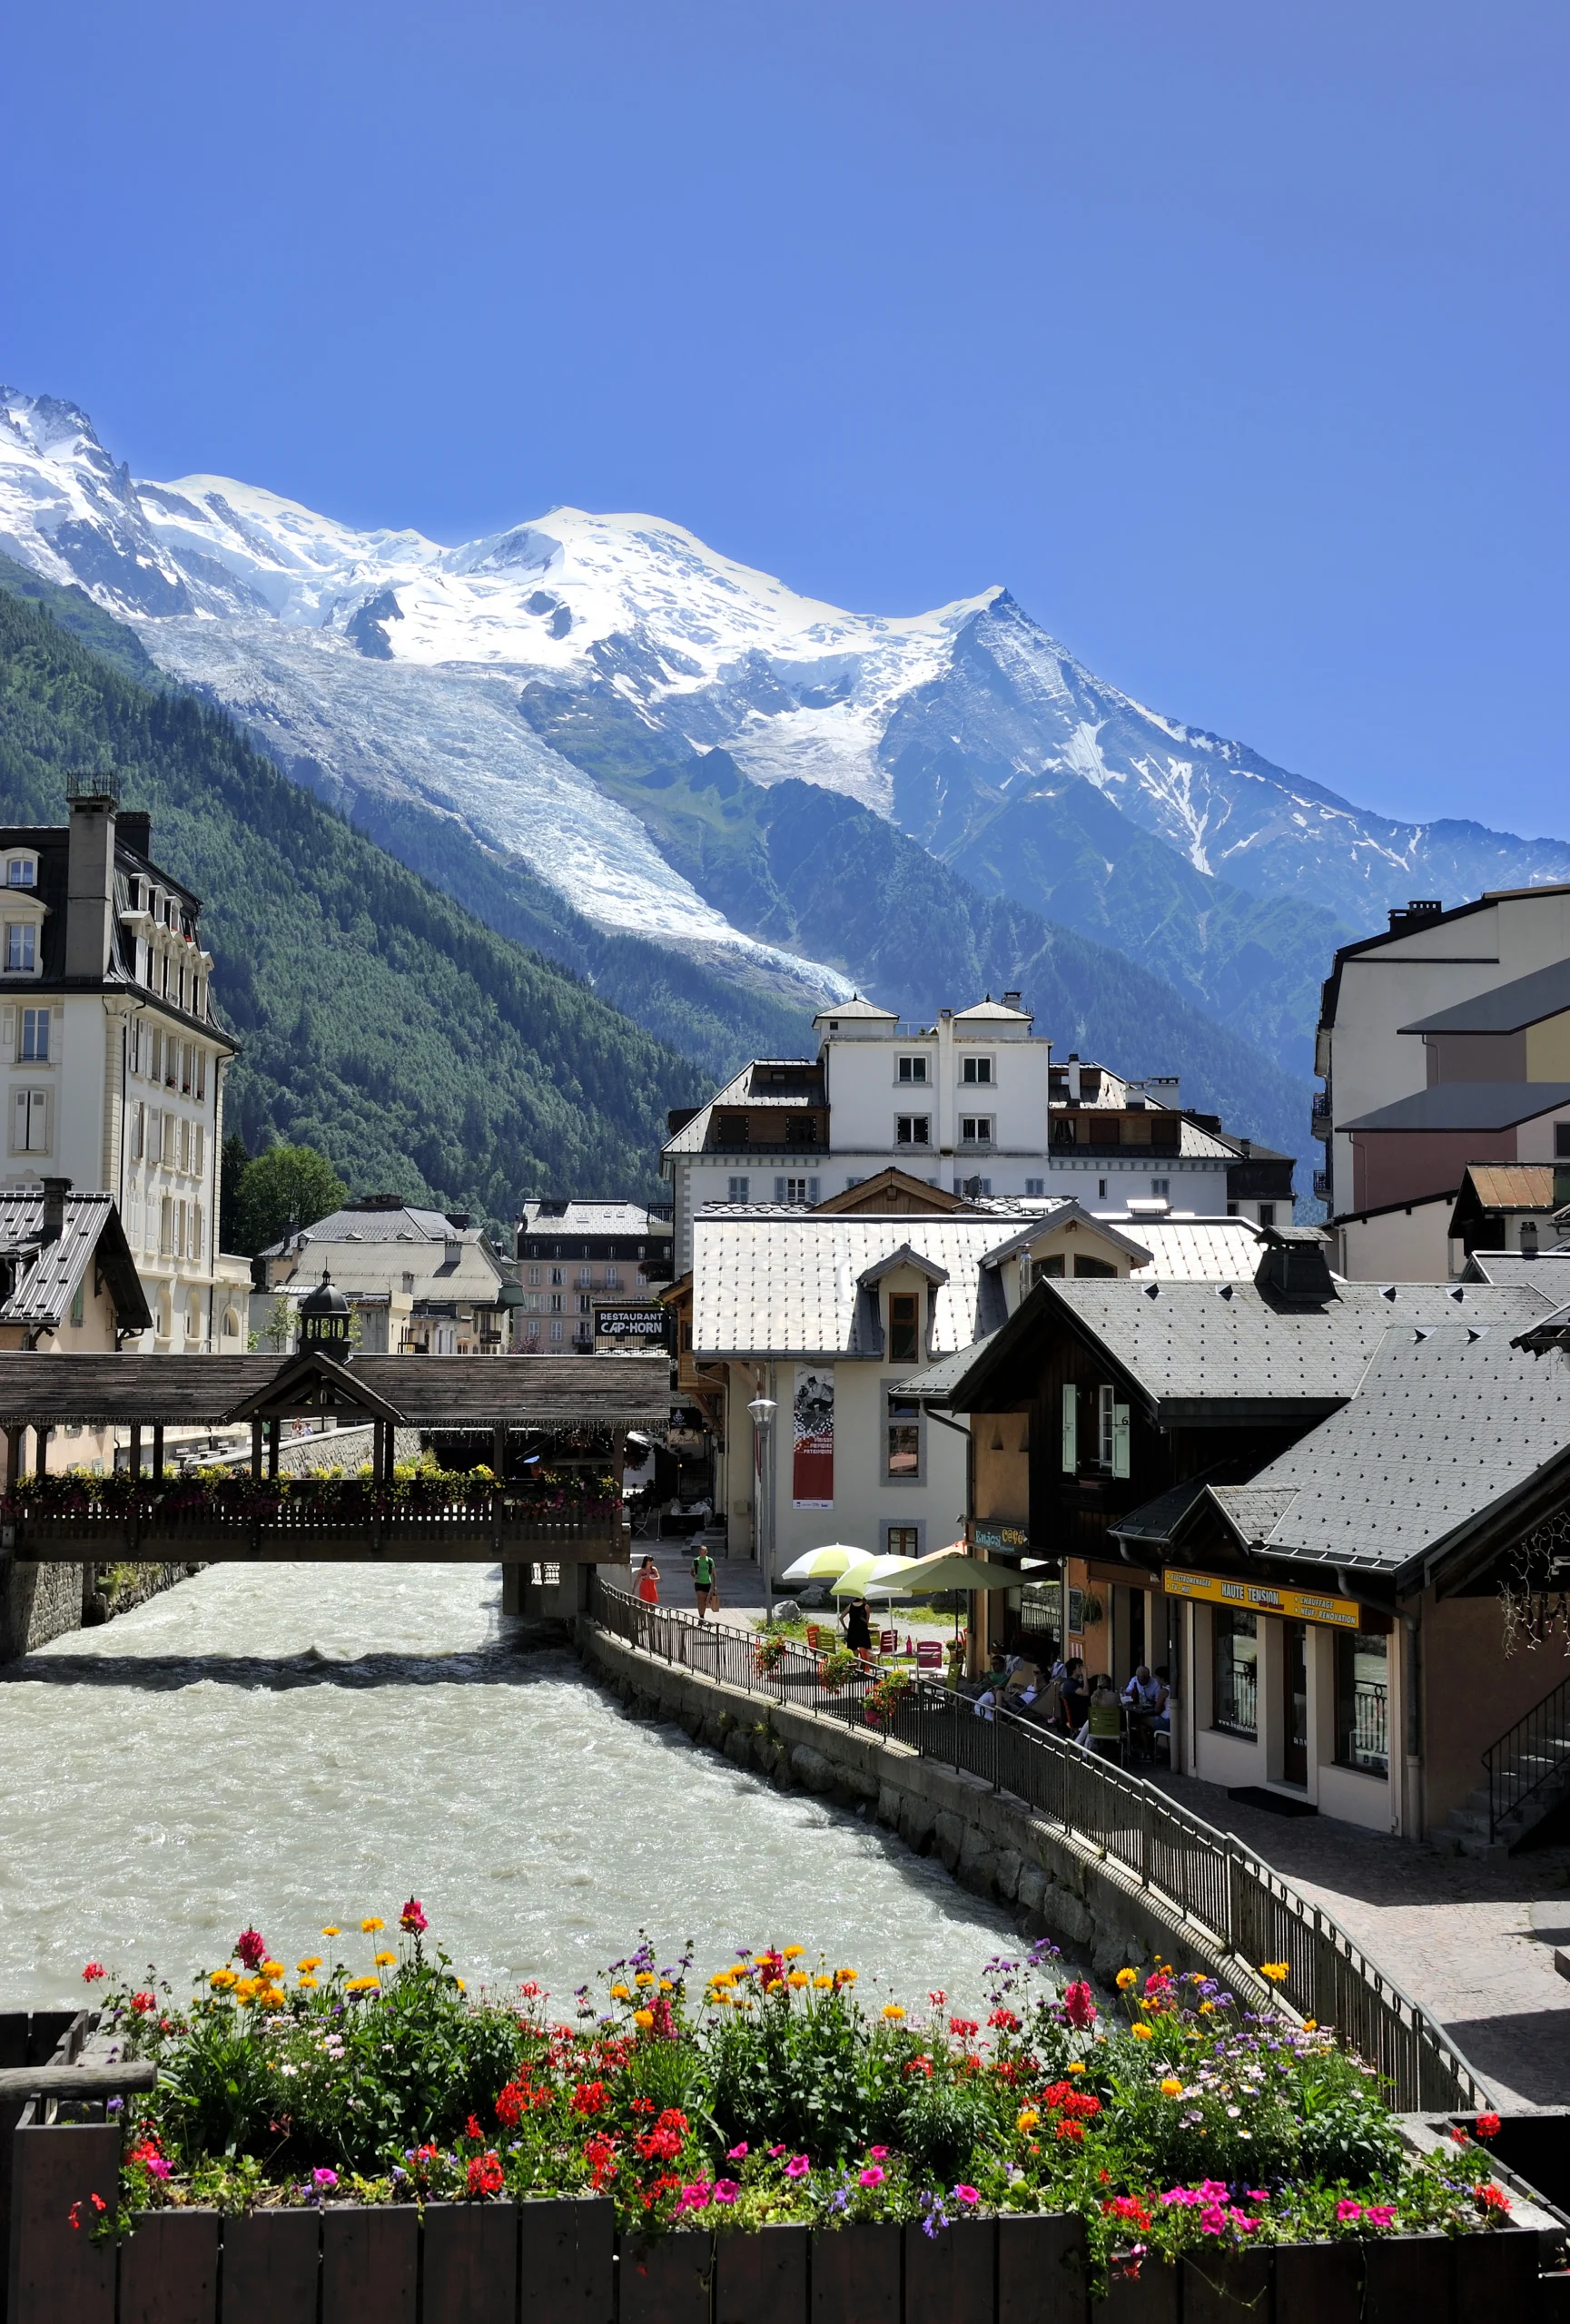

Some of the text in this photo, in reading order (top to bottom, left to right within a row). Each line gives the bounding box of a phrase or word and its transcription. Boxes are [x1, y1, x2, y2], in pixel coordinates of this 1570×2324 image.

[600, 1313, 663, 1321] RESTAURANT
[975, 1530, 1001, 1547] Enjoy
[1221, 1582, 1279, 1605] HAUTE TENSION
[1300, 1596, 1334, 1610] CHAUFFAGE
